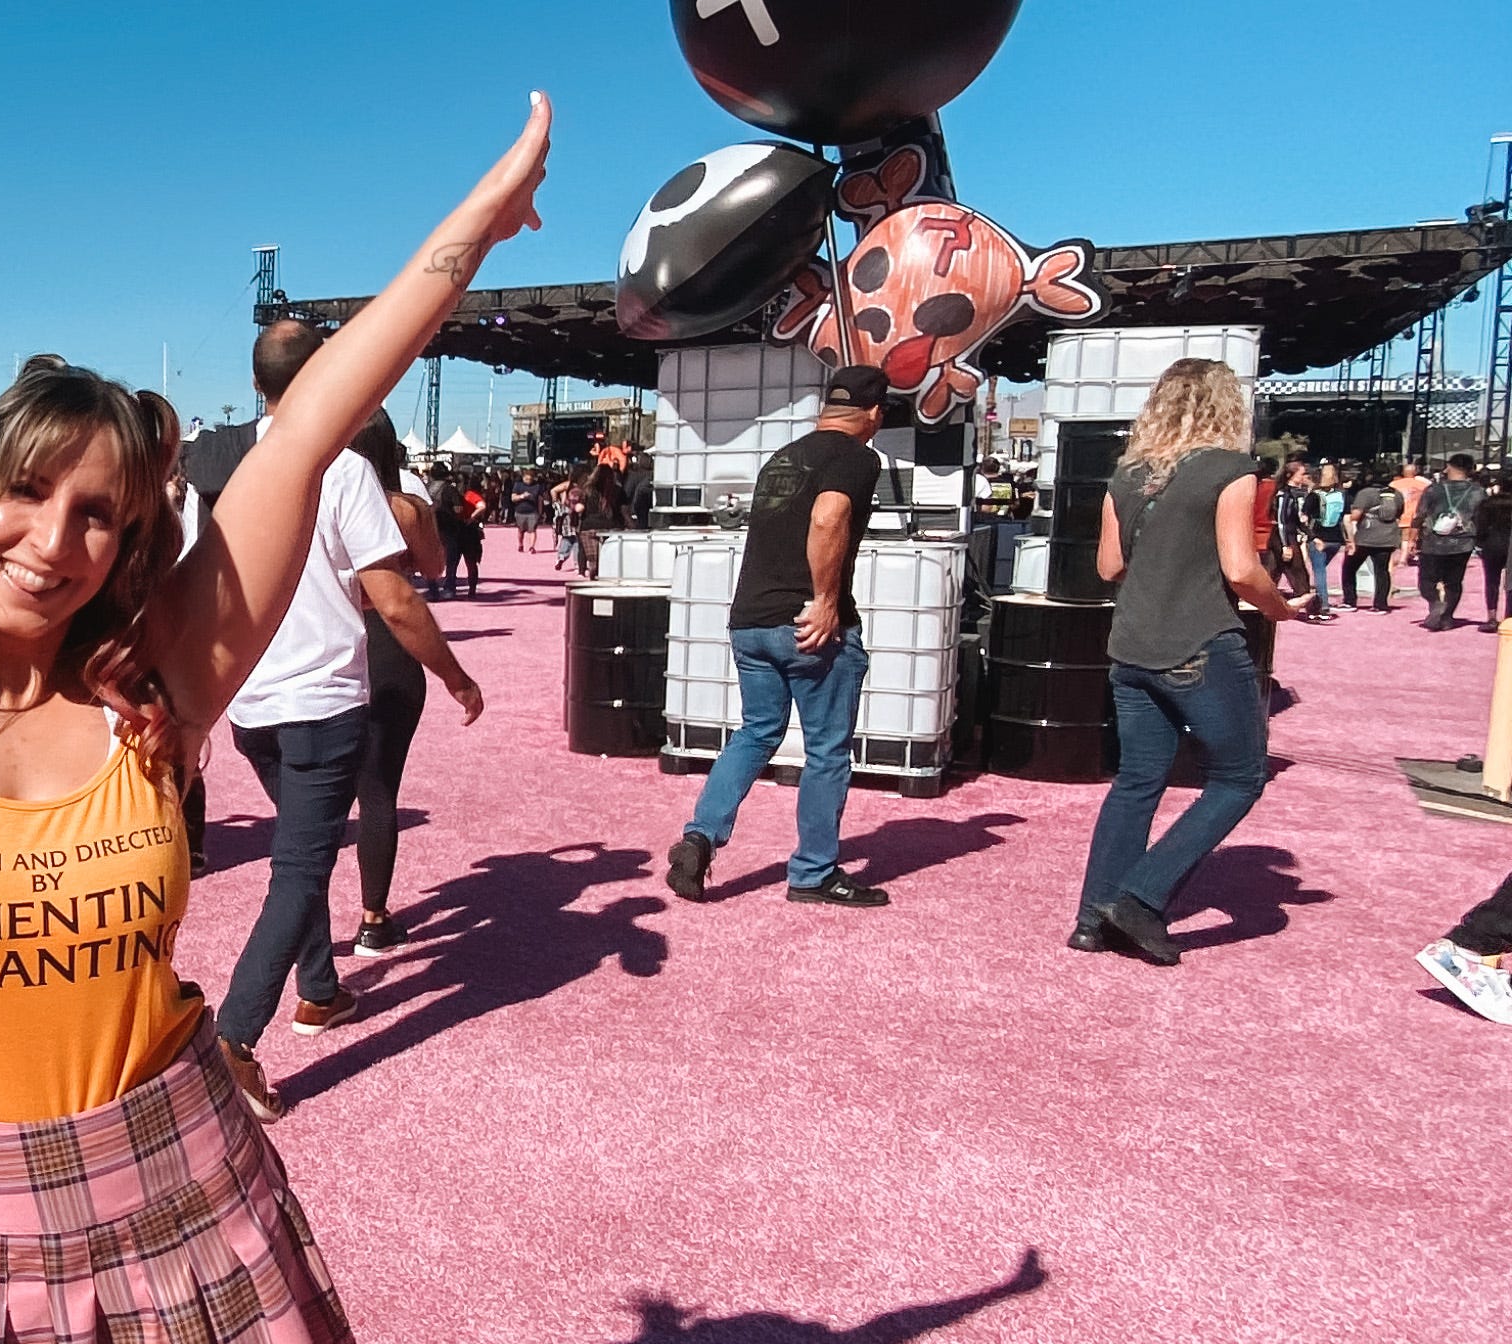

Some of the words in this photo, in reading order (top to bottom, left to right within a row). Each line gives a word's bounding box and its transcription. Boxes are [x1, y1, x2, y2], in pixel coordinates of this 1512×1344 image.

[12, 849, 68, 871] AND
[75, 825, 175, 863] DIRECTED
[31, 871, 65, 893] BY
